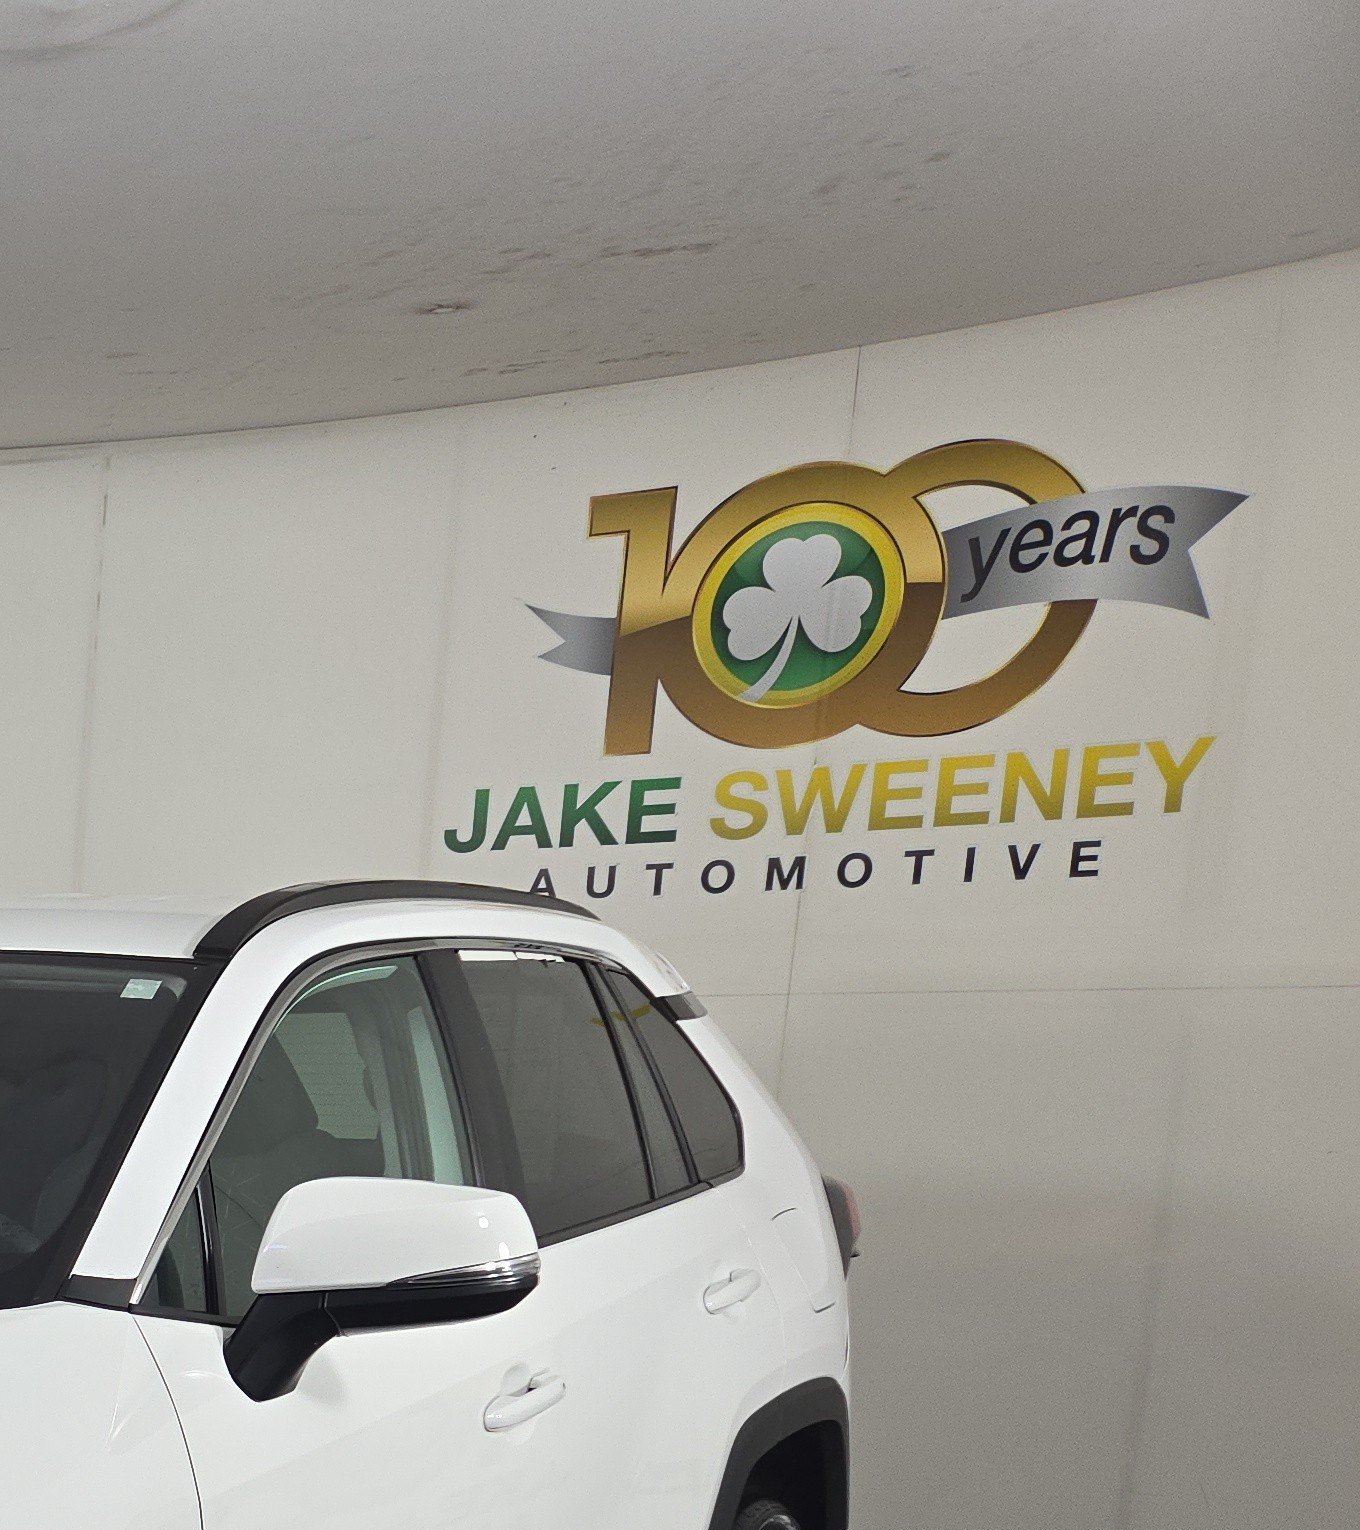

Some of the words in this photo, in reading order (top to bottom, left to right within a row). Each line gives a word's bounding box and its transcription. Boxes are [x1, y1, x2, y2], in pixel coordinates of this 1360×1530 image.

[588, 438, 1101, 755] 100
[960, 502, 1176, 603] years
[444, 776, 682, 853] JAKE
[710, 736, 1215, 842] SWEENEY
[530, 840, 1102, 898] AUTOMOTIVE
